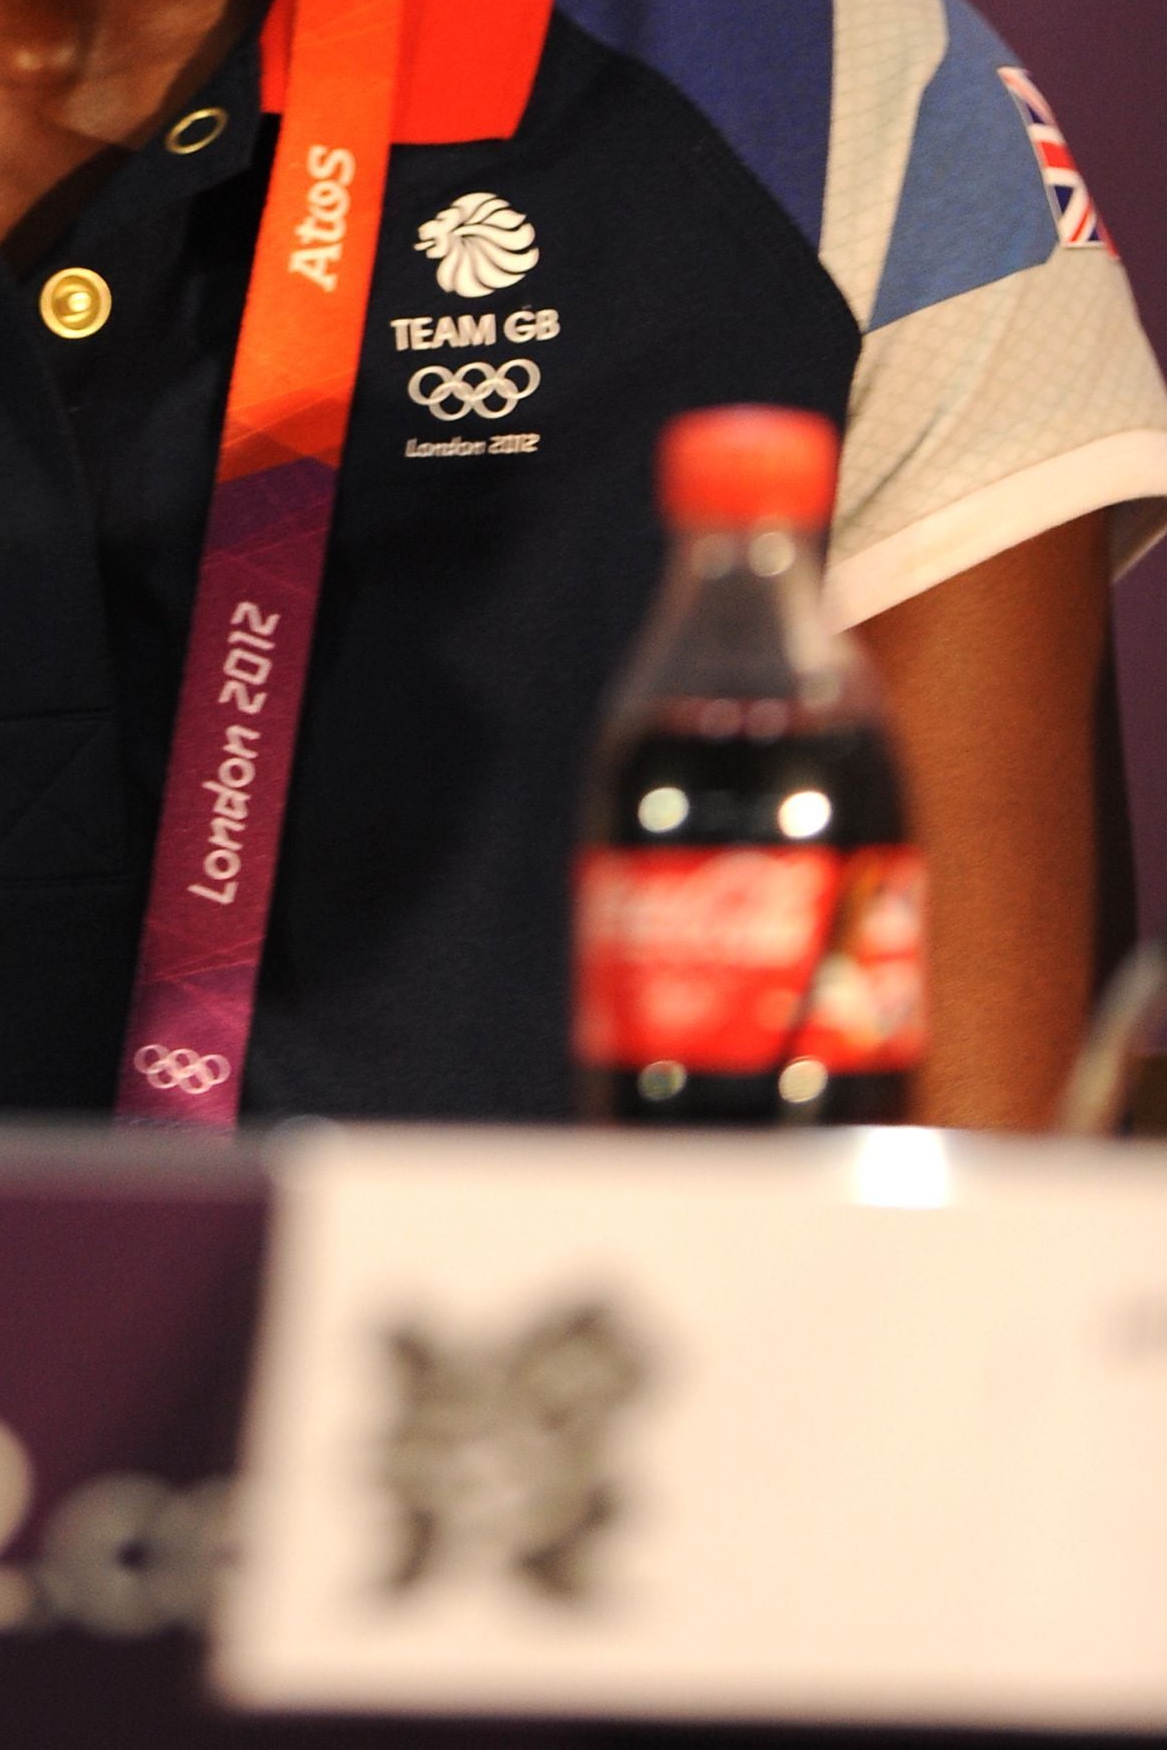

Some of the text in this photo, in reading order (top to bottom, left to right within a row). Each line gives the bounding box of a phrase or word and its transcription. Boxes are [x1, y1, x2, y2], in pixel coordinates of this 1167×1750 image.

[390, 308, 561, 351] TEAM GB
[405, 435, 487, 458] London
[187, 601, 280, 906] London 2012
